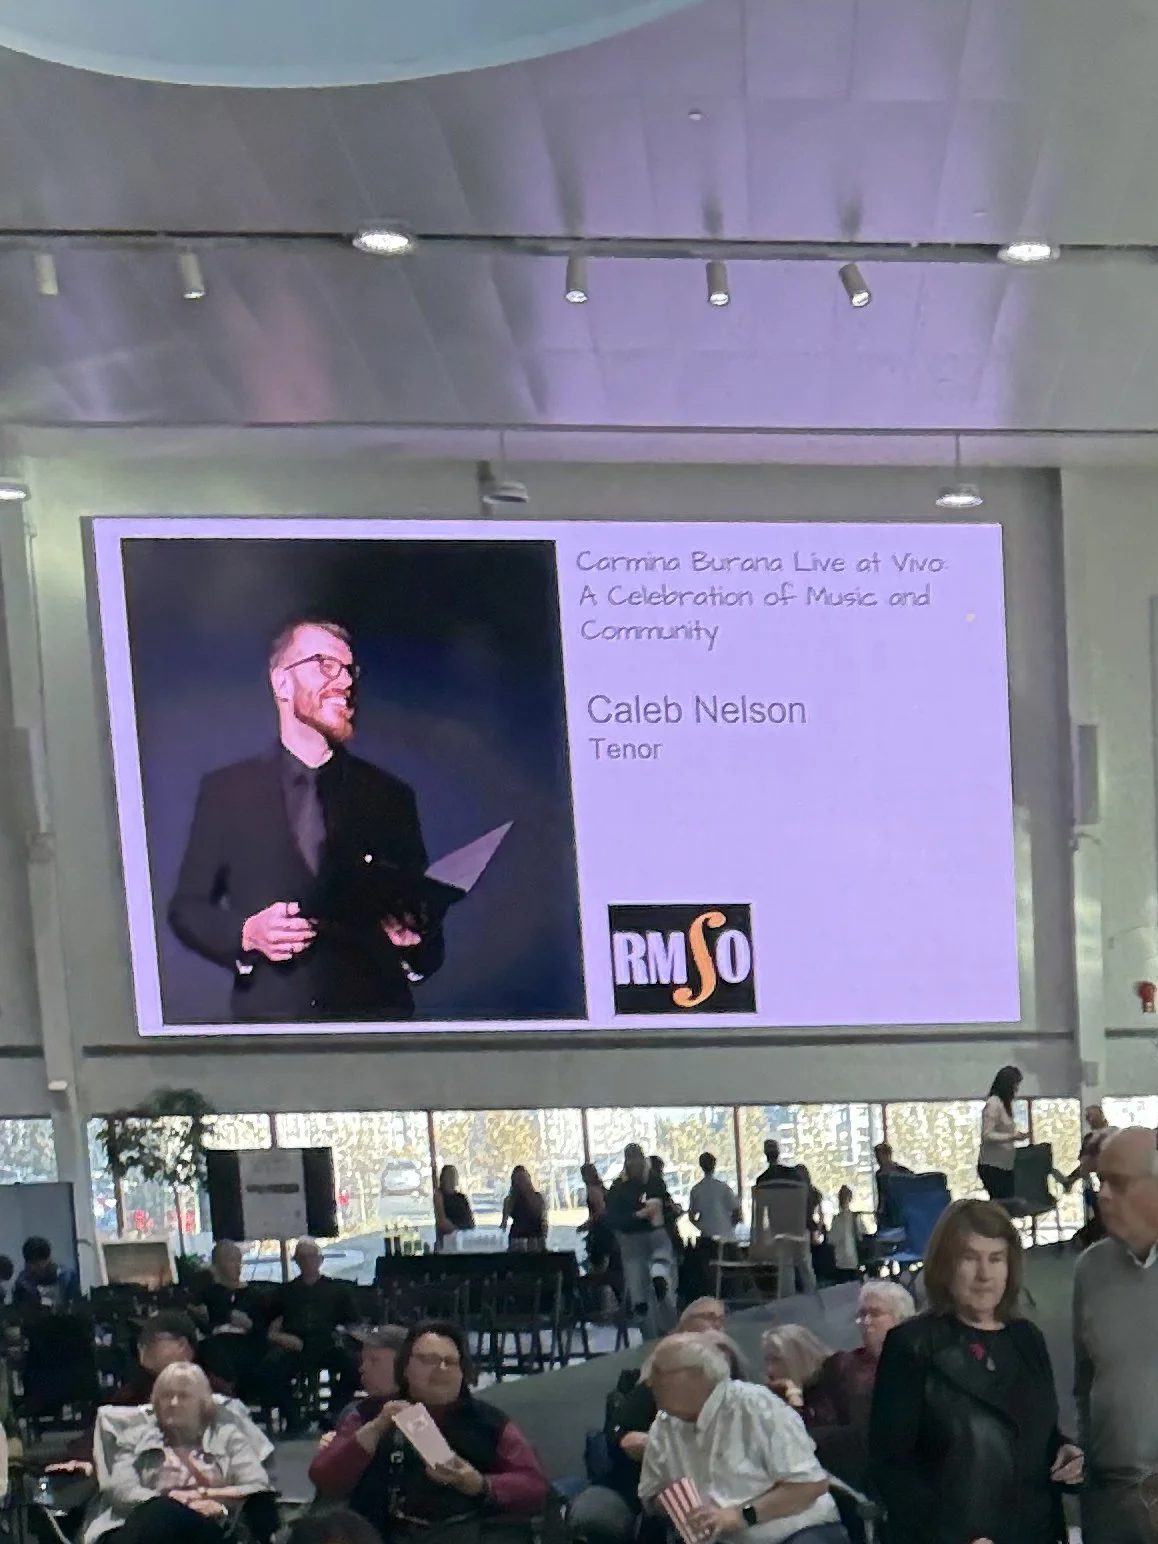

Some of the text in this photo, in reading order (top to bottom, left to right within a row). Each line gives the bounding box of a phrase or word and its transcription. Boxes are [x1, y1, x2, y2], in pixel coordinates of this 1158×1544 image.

[576, 551, 681, 573] Carmina
[691, 550, 784, 573] Burana
[793, 551, 846, 573] Live
[855, 551, 882, 573] at
[579, 580, 931, 607] A Celebration of Music and
[580, 618, 720, 652] Community
[586, 694, 807, 725] Caleb Nelson
[587, 737, 664, 761] Tenor
[612, 911, 751, 1008] RMSO
